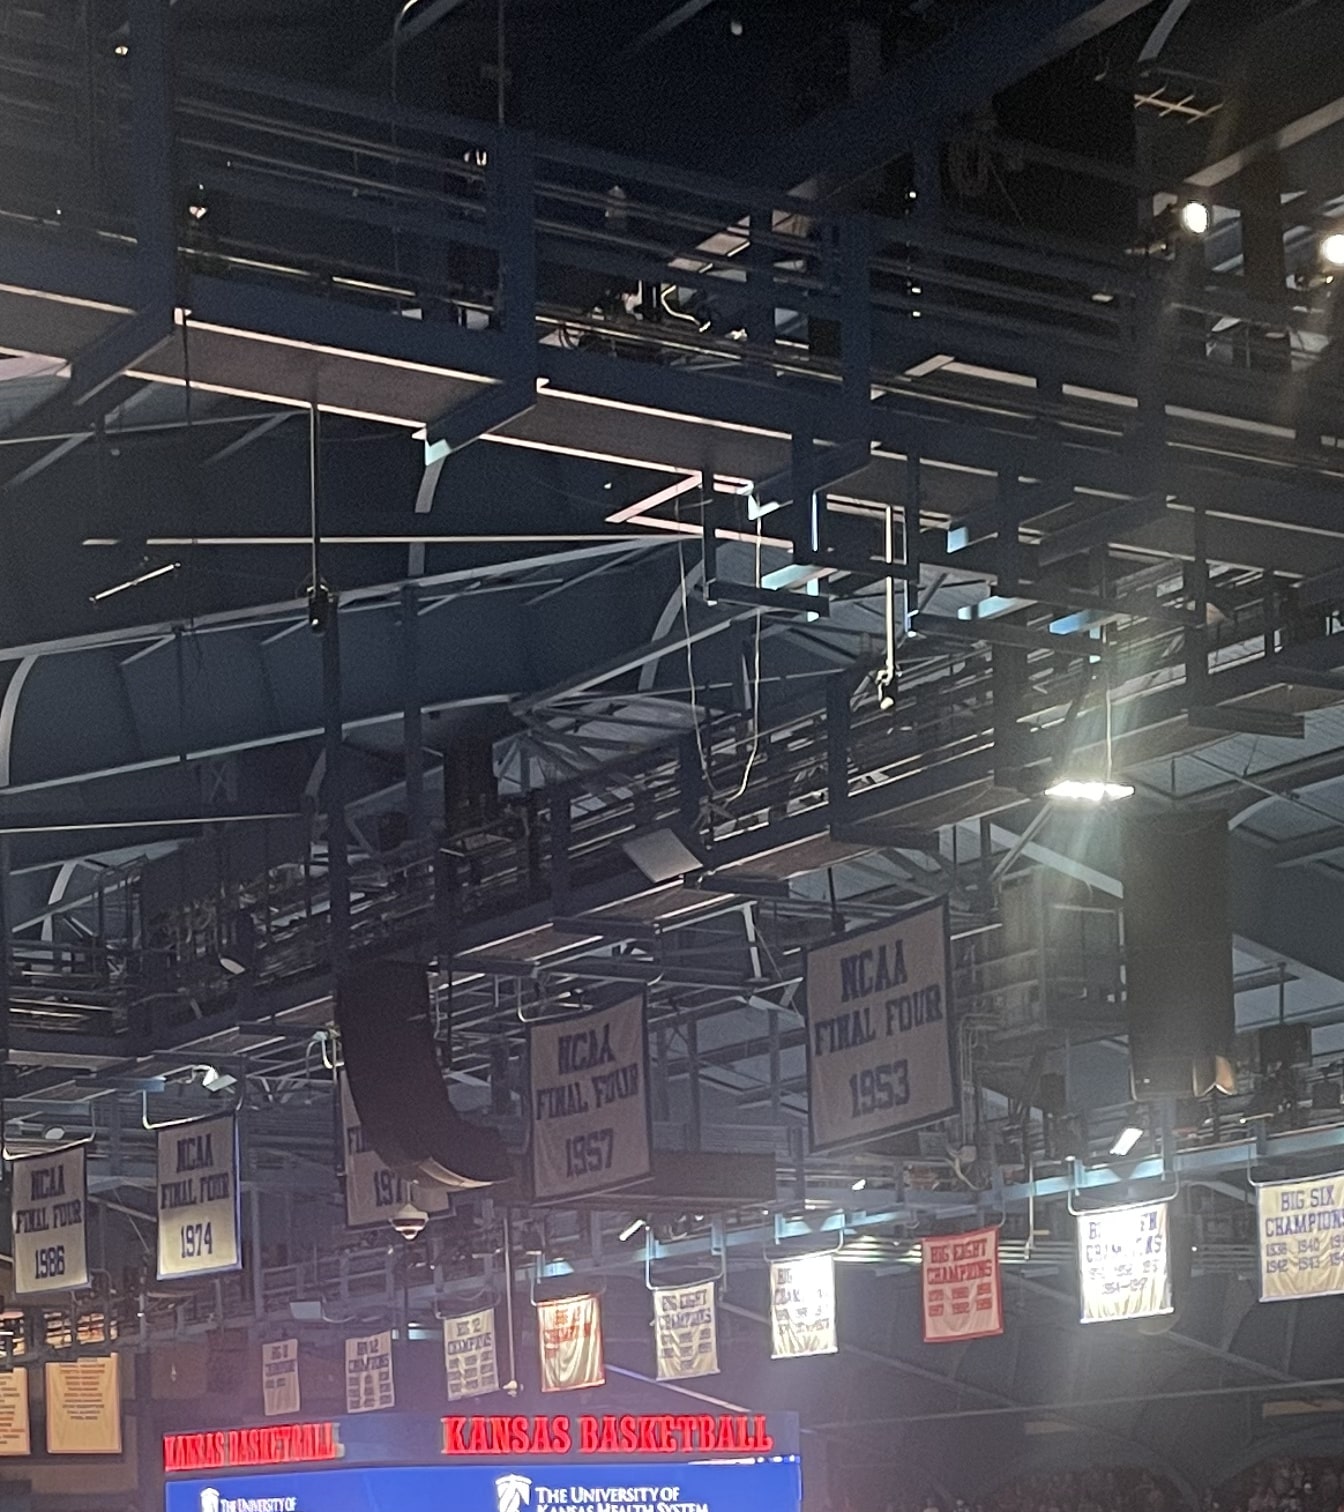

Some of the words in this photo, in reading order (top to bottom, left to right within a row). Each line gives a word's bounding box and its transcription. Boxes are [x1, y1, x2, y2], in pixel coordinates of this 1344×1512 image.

[840, 938, 908, 1003] NCAA
[814, 1011, 876, 1057] FINAL
[886, 983, 943, 1037] FOUR
[557, 1023, 615, 1075] NCAA
[535, 1082, 589, 1121] FINAL
[592, 1062, 640, 1109] FOUR
[847, 1059, 910, 1118] 1953
[176, 1133, 214, 1173] NCAA
[565, 1128, 615, 1178] 1957
[30, 1164, 66, 1201] NCAA
[160, 1179, 196, 1210] FINAL
[200, 1172, 230, 1204] FOUR
[1280, 1187, 1306, 1212] BIG
[1309, 1184, 1335, 1207] SIX
[15, 1206, 50, 1234] FINAL
[52, 1198, 83, 1229] FOUR
[181, 1222, 213, 1258] 1974
[35, 1245, 65, 1280] 1986
[926, 1259, 993, 1285] CHAMPIONS
[164, 1431, 225, 1472] KANSAS
[229, 1422, 340, 1465] BASKETBALL
[441, 1414, 571, 1455] KANSAS
[579, 1413, 774, 1453] BASKETBALL
[286, 1496, 297, 1511] OF
[535, 1487, 568, 1504] THE
[570, 1486, 659, 1504] UNIVERSITY
[660, 1486, 680, 1502] OF
